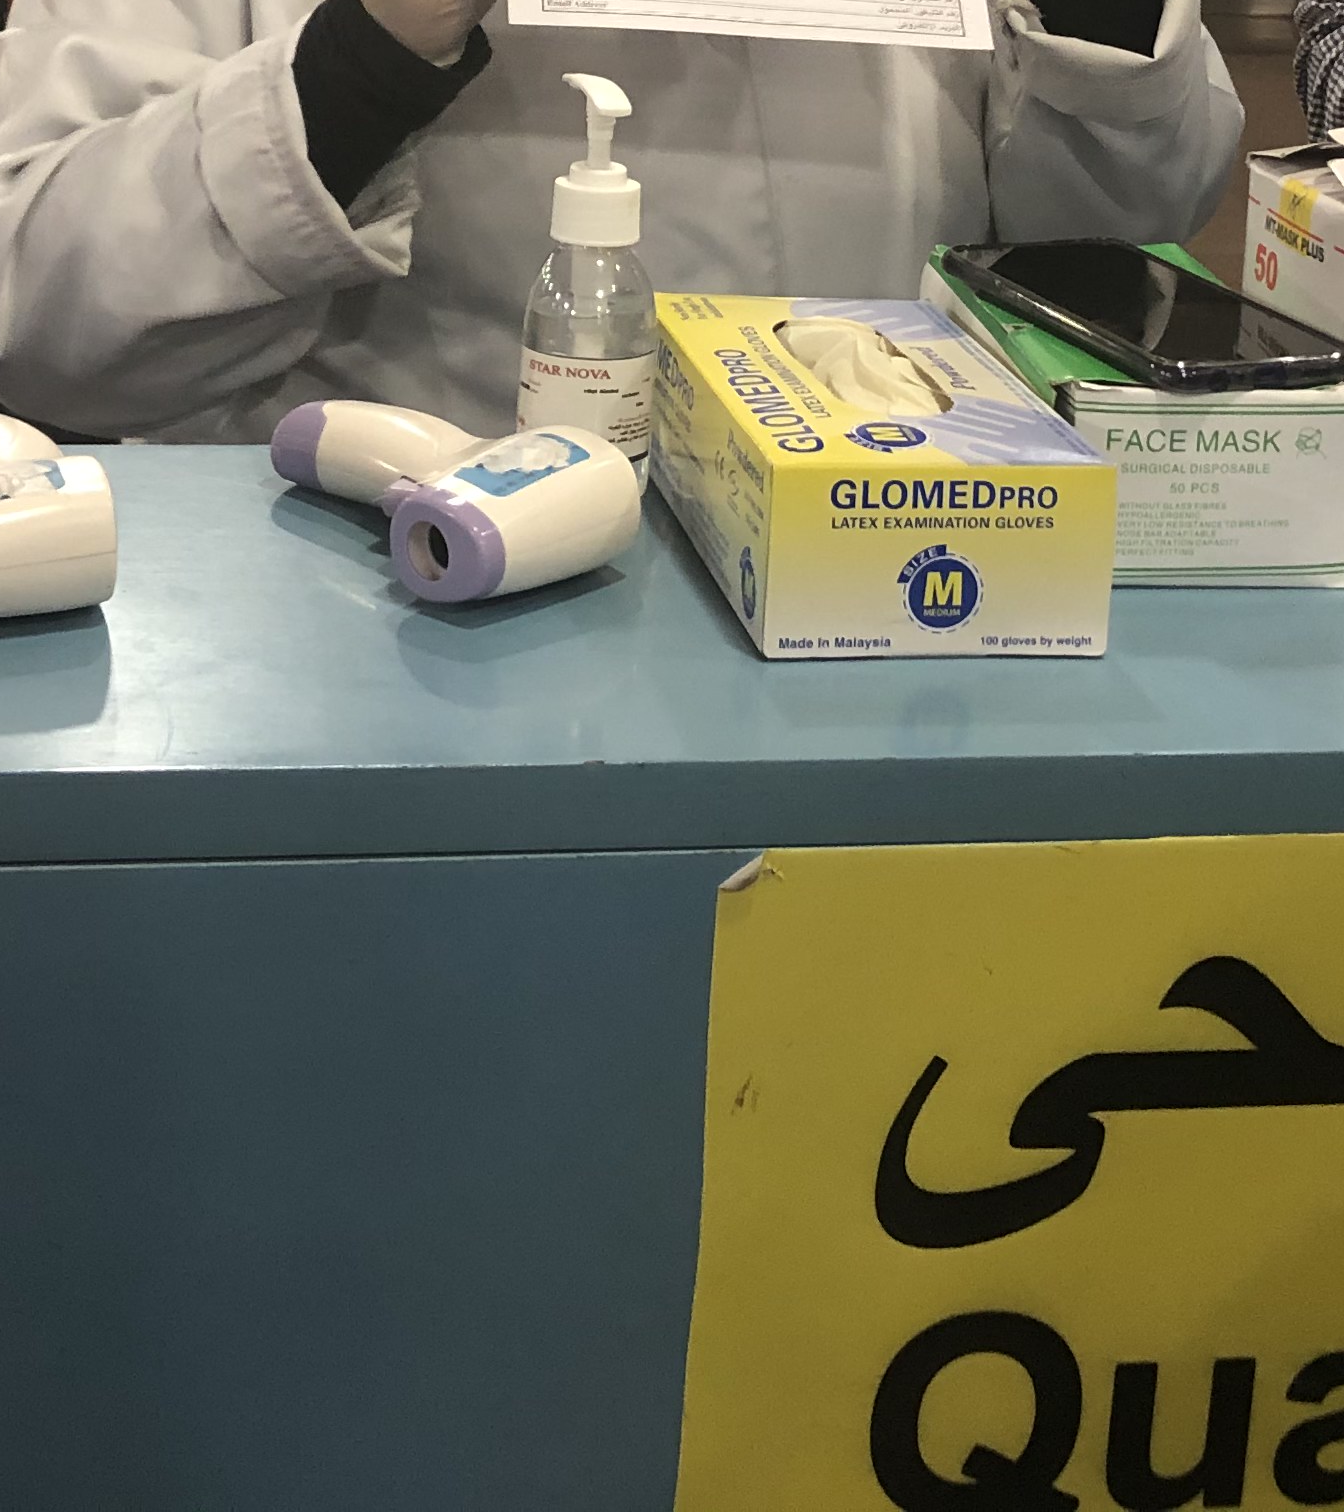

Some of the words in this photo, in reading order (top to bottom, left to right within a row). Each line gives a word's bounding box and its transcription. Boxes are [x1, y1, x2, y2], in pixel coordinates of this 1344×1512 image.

[1300, 237, 1325, 265] PLUS
[1255, 243, 1278, 291] 50
[529, 359, 561, 377] STAR
[565, 367, 611, 380] NOVA
[656, 338, 694, 411] MEDPRO
[714, 349, 824, 453] GLOMEDPRO
[867, 426, 909, 442] M
[1106, 428, 1188, 453] FACE
[1196, 429, 1281, 453] MASK
[1121, 463, 1186, 474] SURGICAL
[1190, 464, 1270, 474] DISPOSABLE
[830, 480, 1058, 510] GLOMEDPRO
[1170, 483, 1186, 494] 50
[1191, 483, 1220, 494] PCS
[1119, 502, 1160, 510] WITHOUT
[1163, 502, 1193, 510] GLASS
[831, 517, 878, 529] LATEX
[884, 517, 990, 529] EXAMINATION
[995, 516, 1054, 529] GLOVES
[1117, 520, 1141, 529] VERY
[1143, 520, 1164, 529] LOW
[903, 547, 938, 578] SIZE
[923, 571, 963, 607] M
[923, 609, 961, 617] MEDIUM
[778, 638, 813, 649] Made
[834, 637, 891, 651] Malaysia
[980, 636, 998, 646] 100
[1002, 636, 1037, 648] gloves
[1040, 636, 1052, 647] by
[1056, 636, 1092, 648] weight
